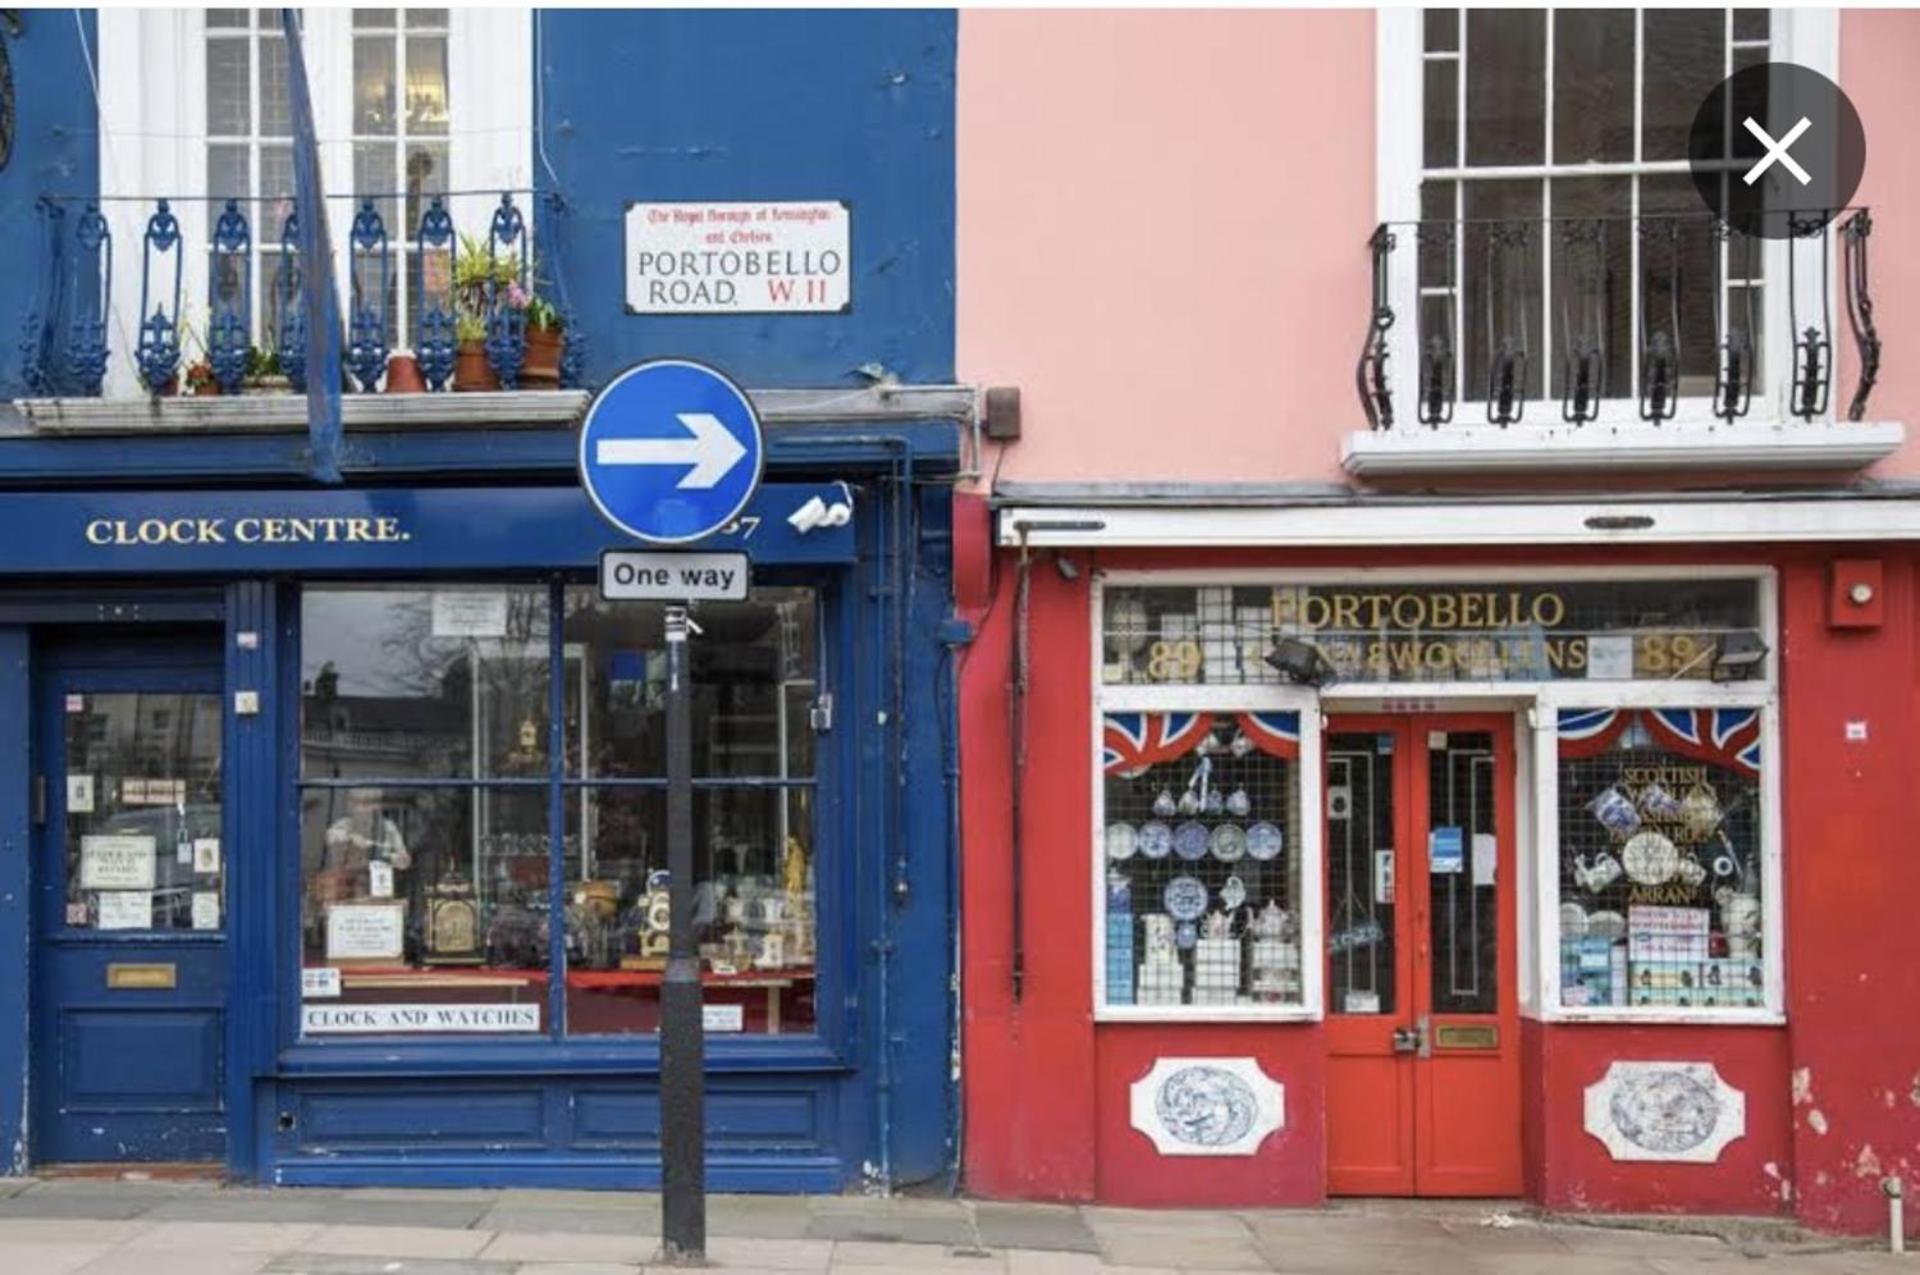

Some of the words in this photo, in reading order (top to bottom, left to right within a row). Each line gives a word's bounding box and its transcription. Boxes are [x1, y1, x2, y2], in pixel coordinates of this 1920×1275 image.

[639, 250, 842, 276] PORTOBELLO
[85, 519, 226, 544] CLOCK
[233, 517, 412, 542] CENTRE.
[719, 516, 761, 540] 7
[614, 562, 670, 586] One
[681, 569, 735, 590] way
[1272, 594, 1565, 629] PORTOBELLO
[308, 1010, 376, 1026] CLOCK
[389, 1010, 429, 1026] AND
[437, 1009, 536, 1026] WATCHES
